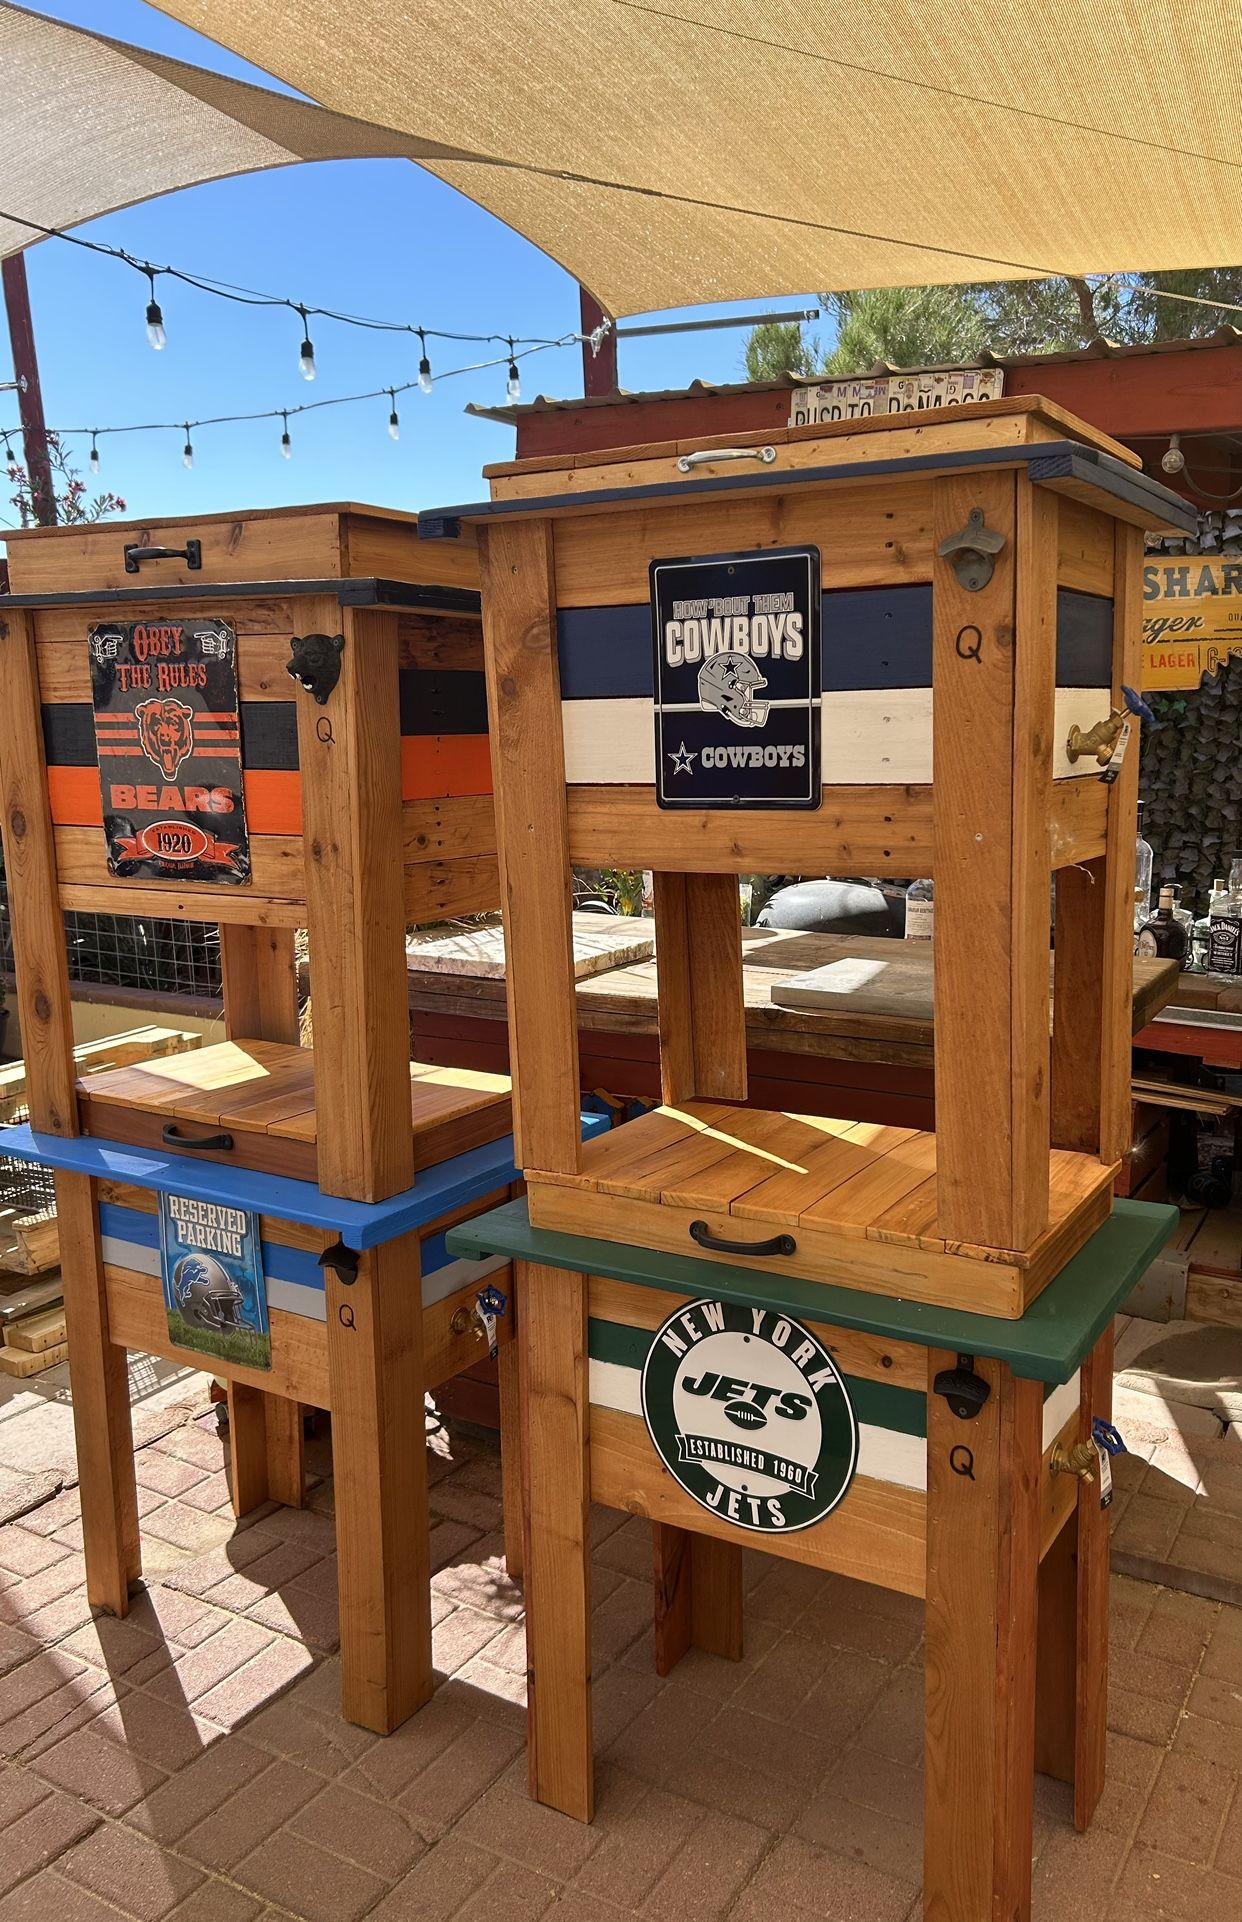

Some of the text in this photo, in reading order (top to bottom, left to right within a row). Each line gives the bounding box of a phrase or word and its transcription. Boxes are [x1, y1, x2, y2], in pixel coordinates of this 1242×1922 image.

[752, 592, 794, 614] THEM
[133, 626, 184, 662] OBEY
[665, 611, 804, 668] COWBOYS
[956, 624, 982, 664] Q
[116, 663, 207, 692] THE RULES
[1150, 653, 1196, 669] LAGER
[316, 716, 336, 744] Q
[701, 745, 805, 768] COWBOYS
[110, 784, 235, 814] BEARS
[157, 832, 193, 854] 1920
[169, 1195, 247, 1234] RESERVED
[177, 1220, 242, 1257] PARKING
[339, 1304, 357, 1332] Q
[661, 1302, 838, 1393] NEW YORK
[681, 1371, 813, 1421] JETS
[690, 1438, 803, 1484] ESTABLISHED 1960
[949, 1444, 976, 1481] Q
[706, 1484, 787, 1527] JETS
